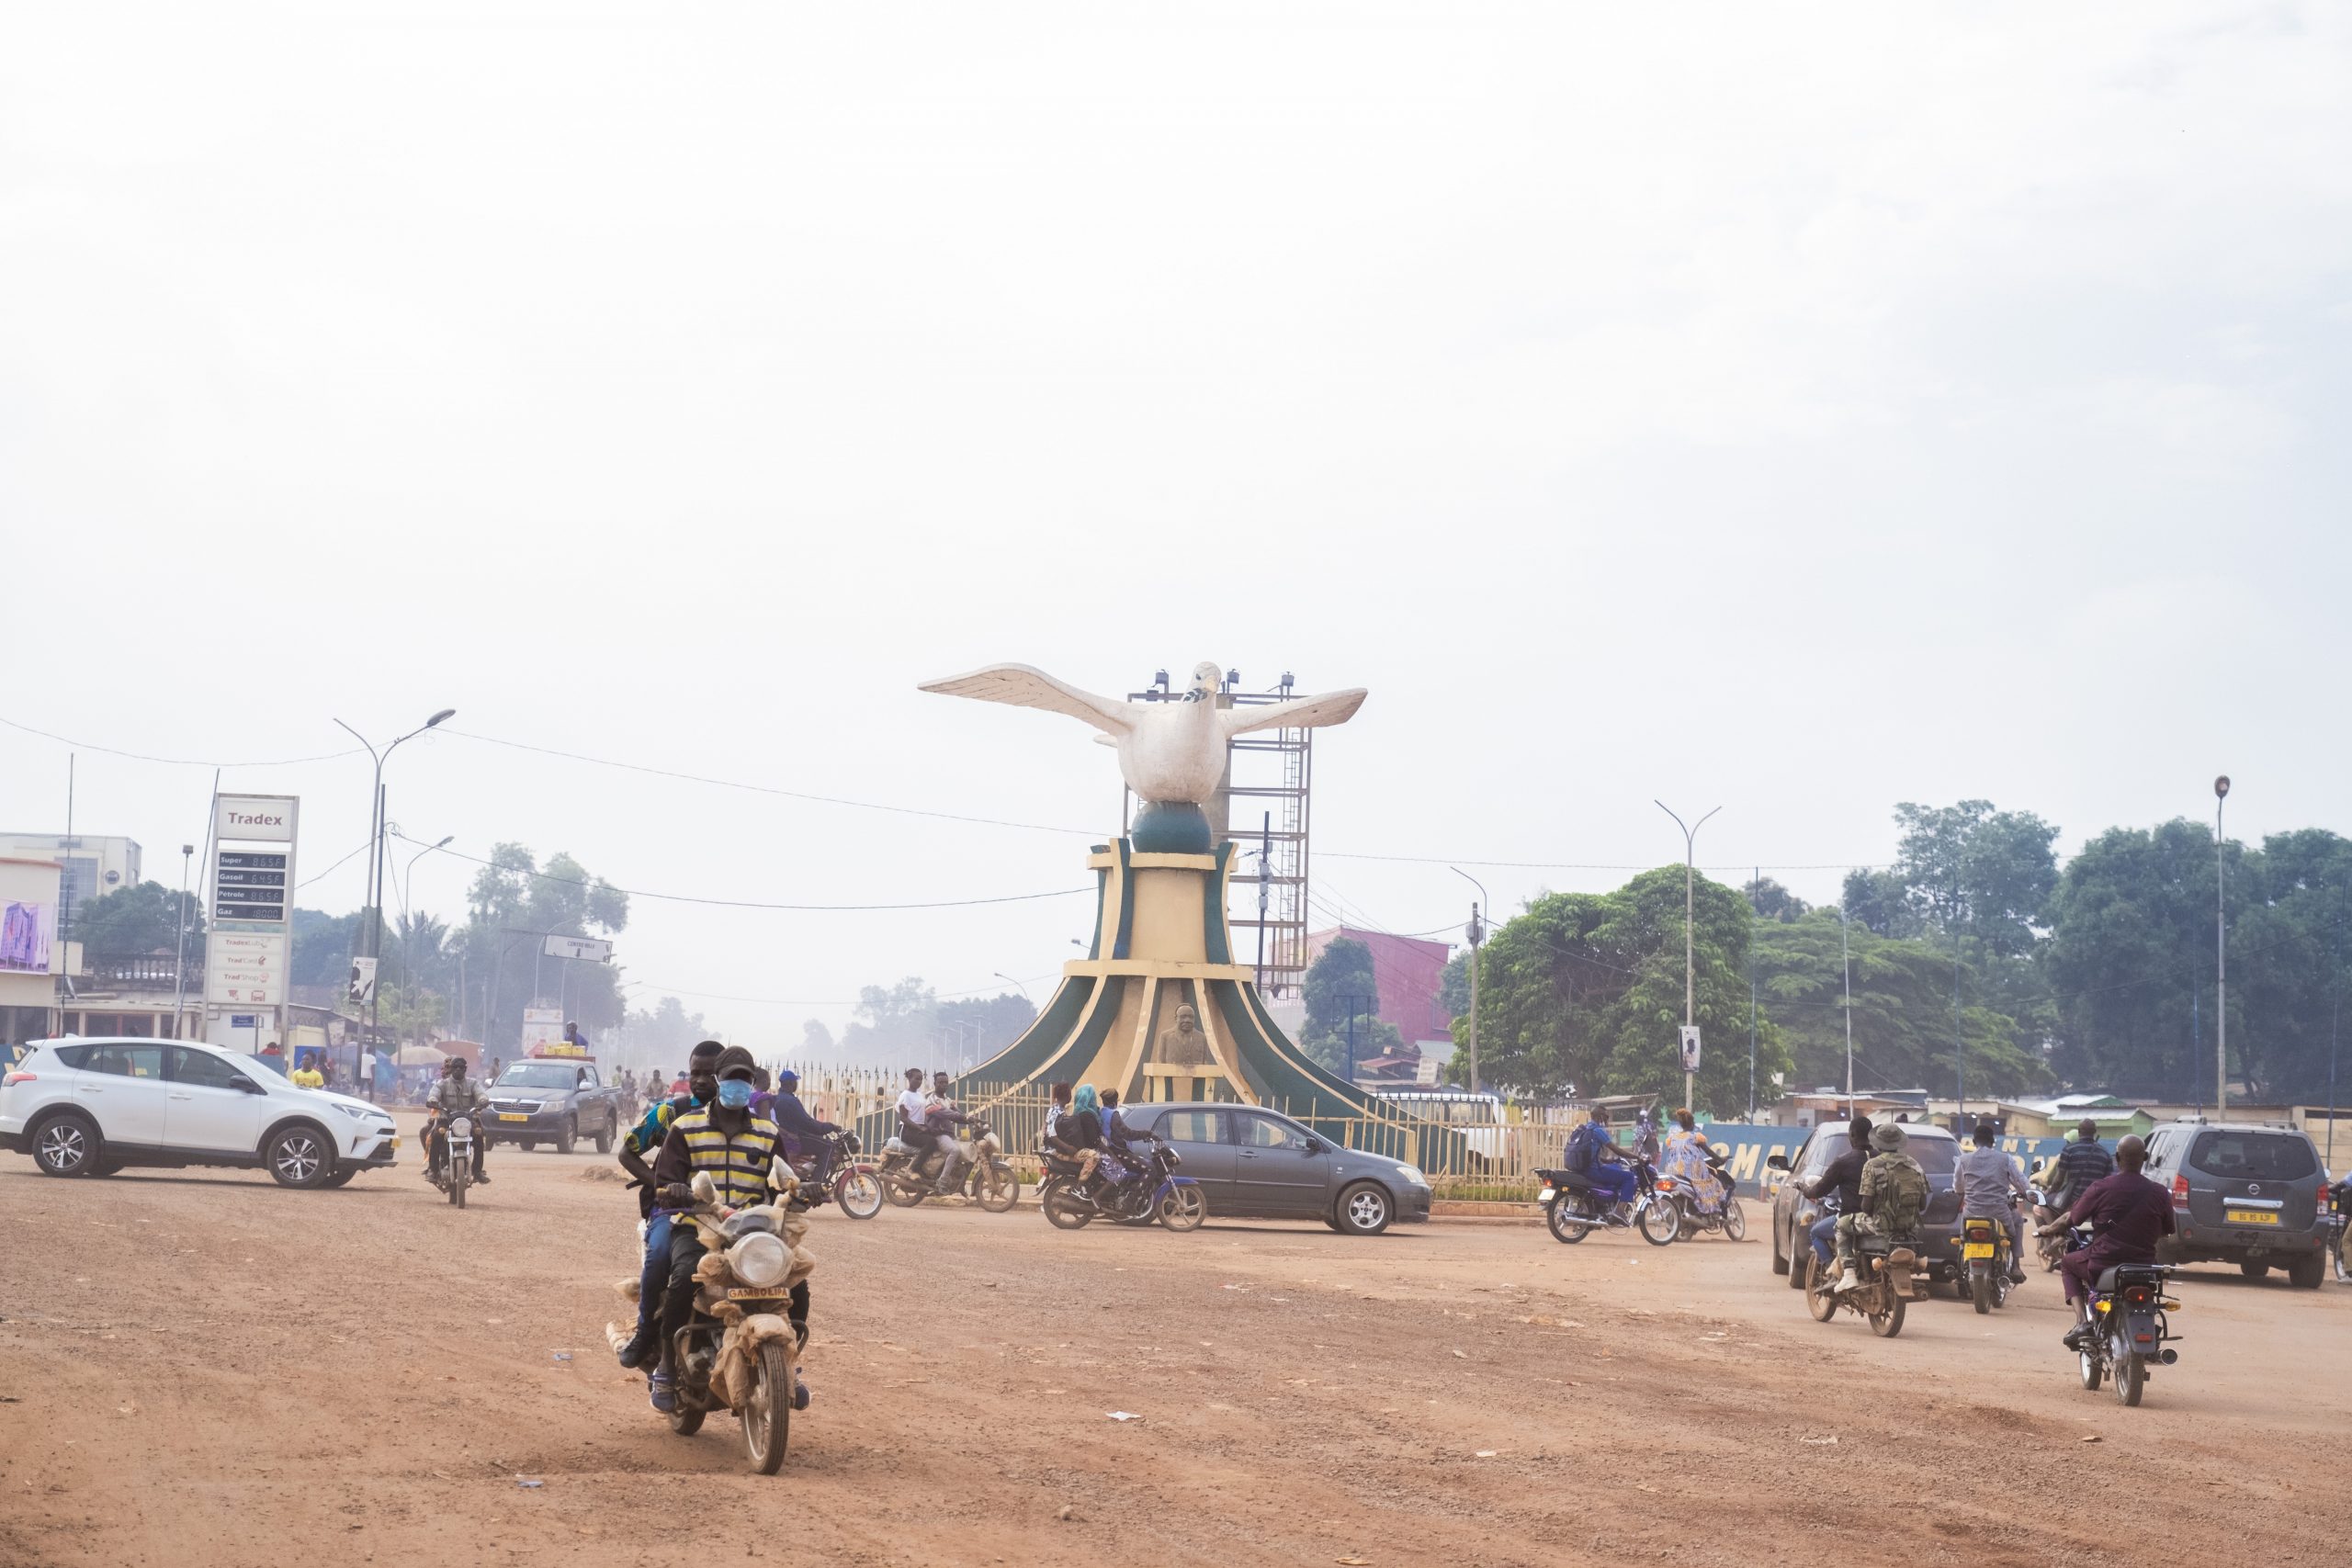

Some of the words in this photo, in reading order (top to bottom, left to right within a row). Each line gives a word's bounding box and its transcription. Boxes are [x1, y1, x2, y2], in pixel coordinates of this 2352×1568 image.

[228, 812, 282, 826] Tradex
[220, 856, 243, 865] Super
[217, 908, 233, 916] Gaz
